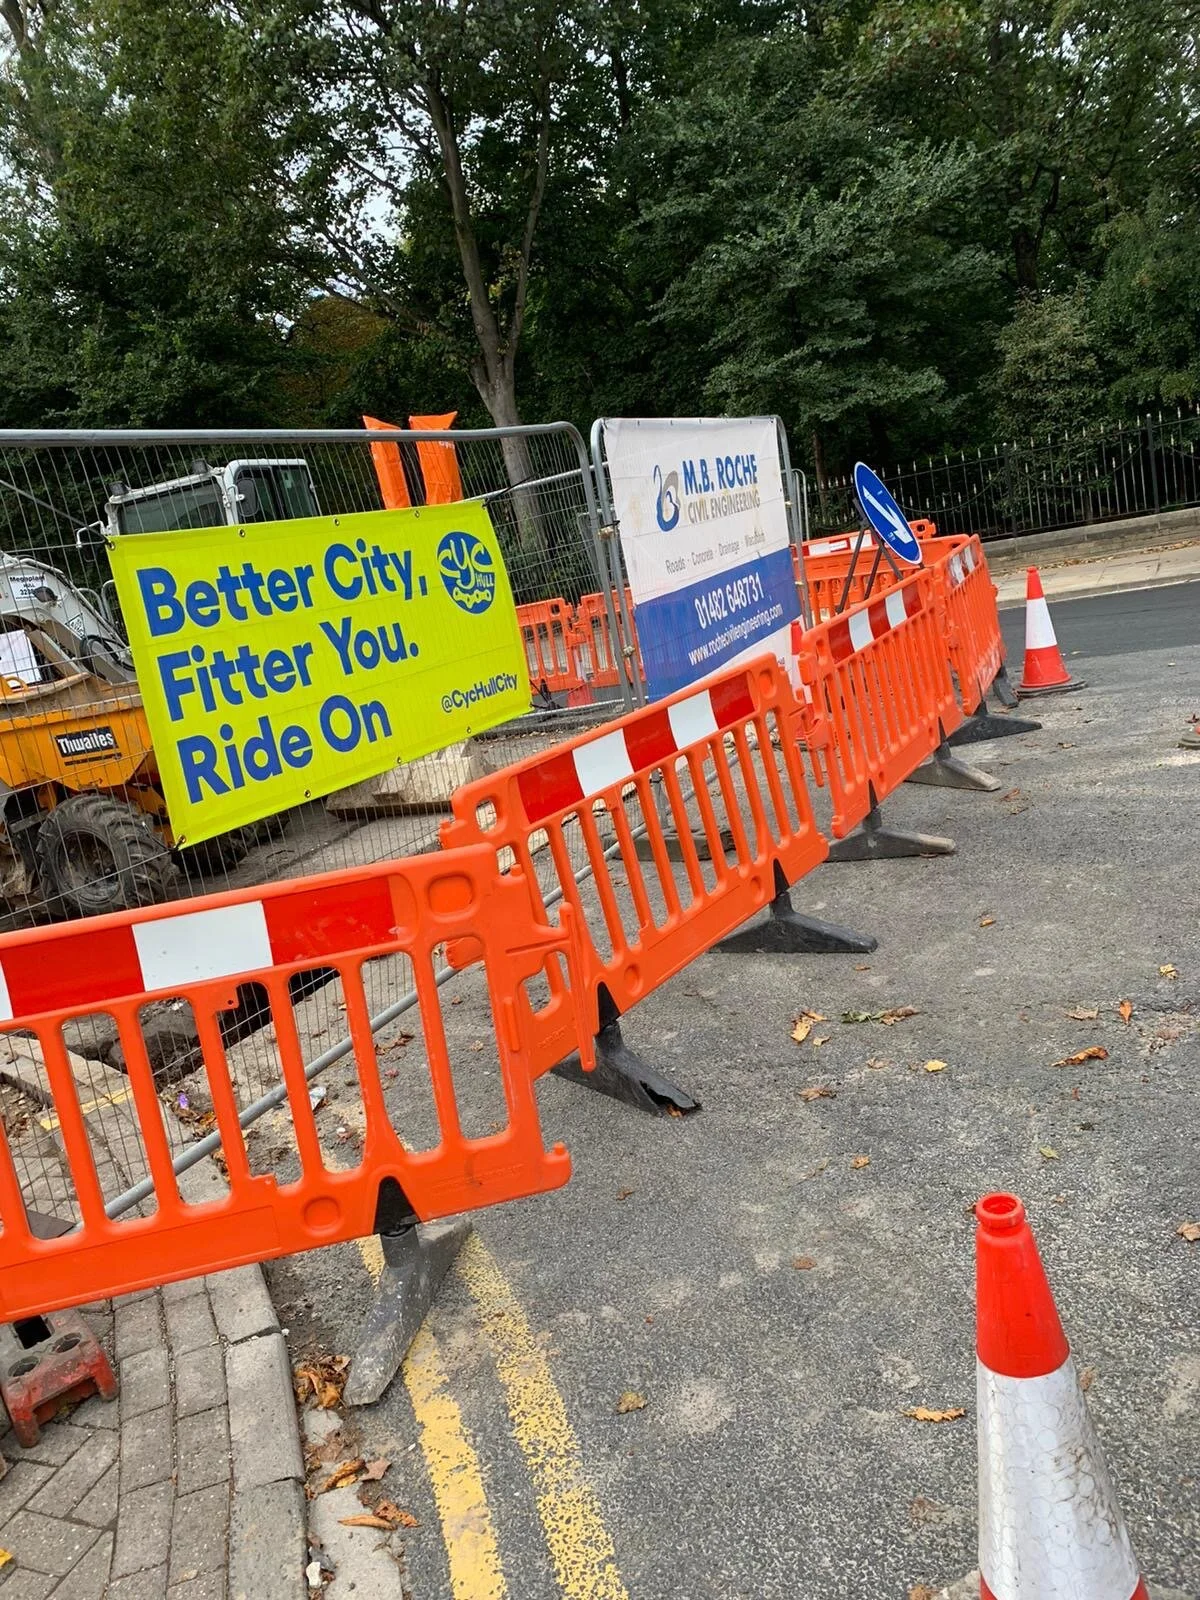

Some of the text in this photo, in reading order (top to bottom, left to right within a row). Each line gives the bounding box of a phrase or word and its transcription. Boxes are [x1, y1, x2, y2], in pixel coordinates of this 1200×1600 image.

[682, 454, 758, 495] M.B. ROCHE
[688, 490, 760, 523] CIVIL ENGINEERING
[665, 557, 687, 575] Roads
[718, 539, 741, 556] Drainage
[136, 538, 428, 636] Better City,
[475, 572, 494, 588] HULL
[694, 571, 764, 629] 01482 648731
[688, 603, 783, 666] www.rochecivilengineering.com
[157, 615, 420, 721] Fitter You.
[441, 673, 518, 713] @CycHullCity
[57, 732, 114, 754] Thwaites
[176, 694, 393, 804] Ride On
